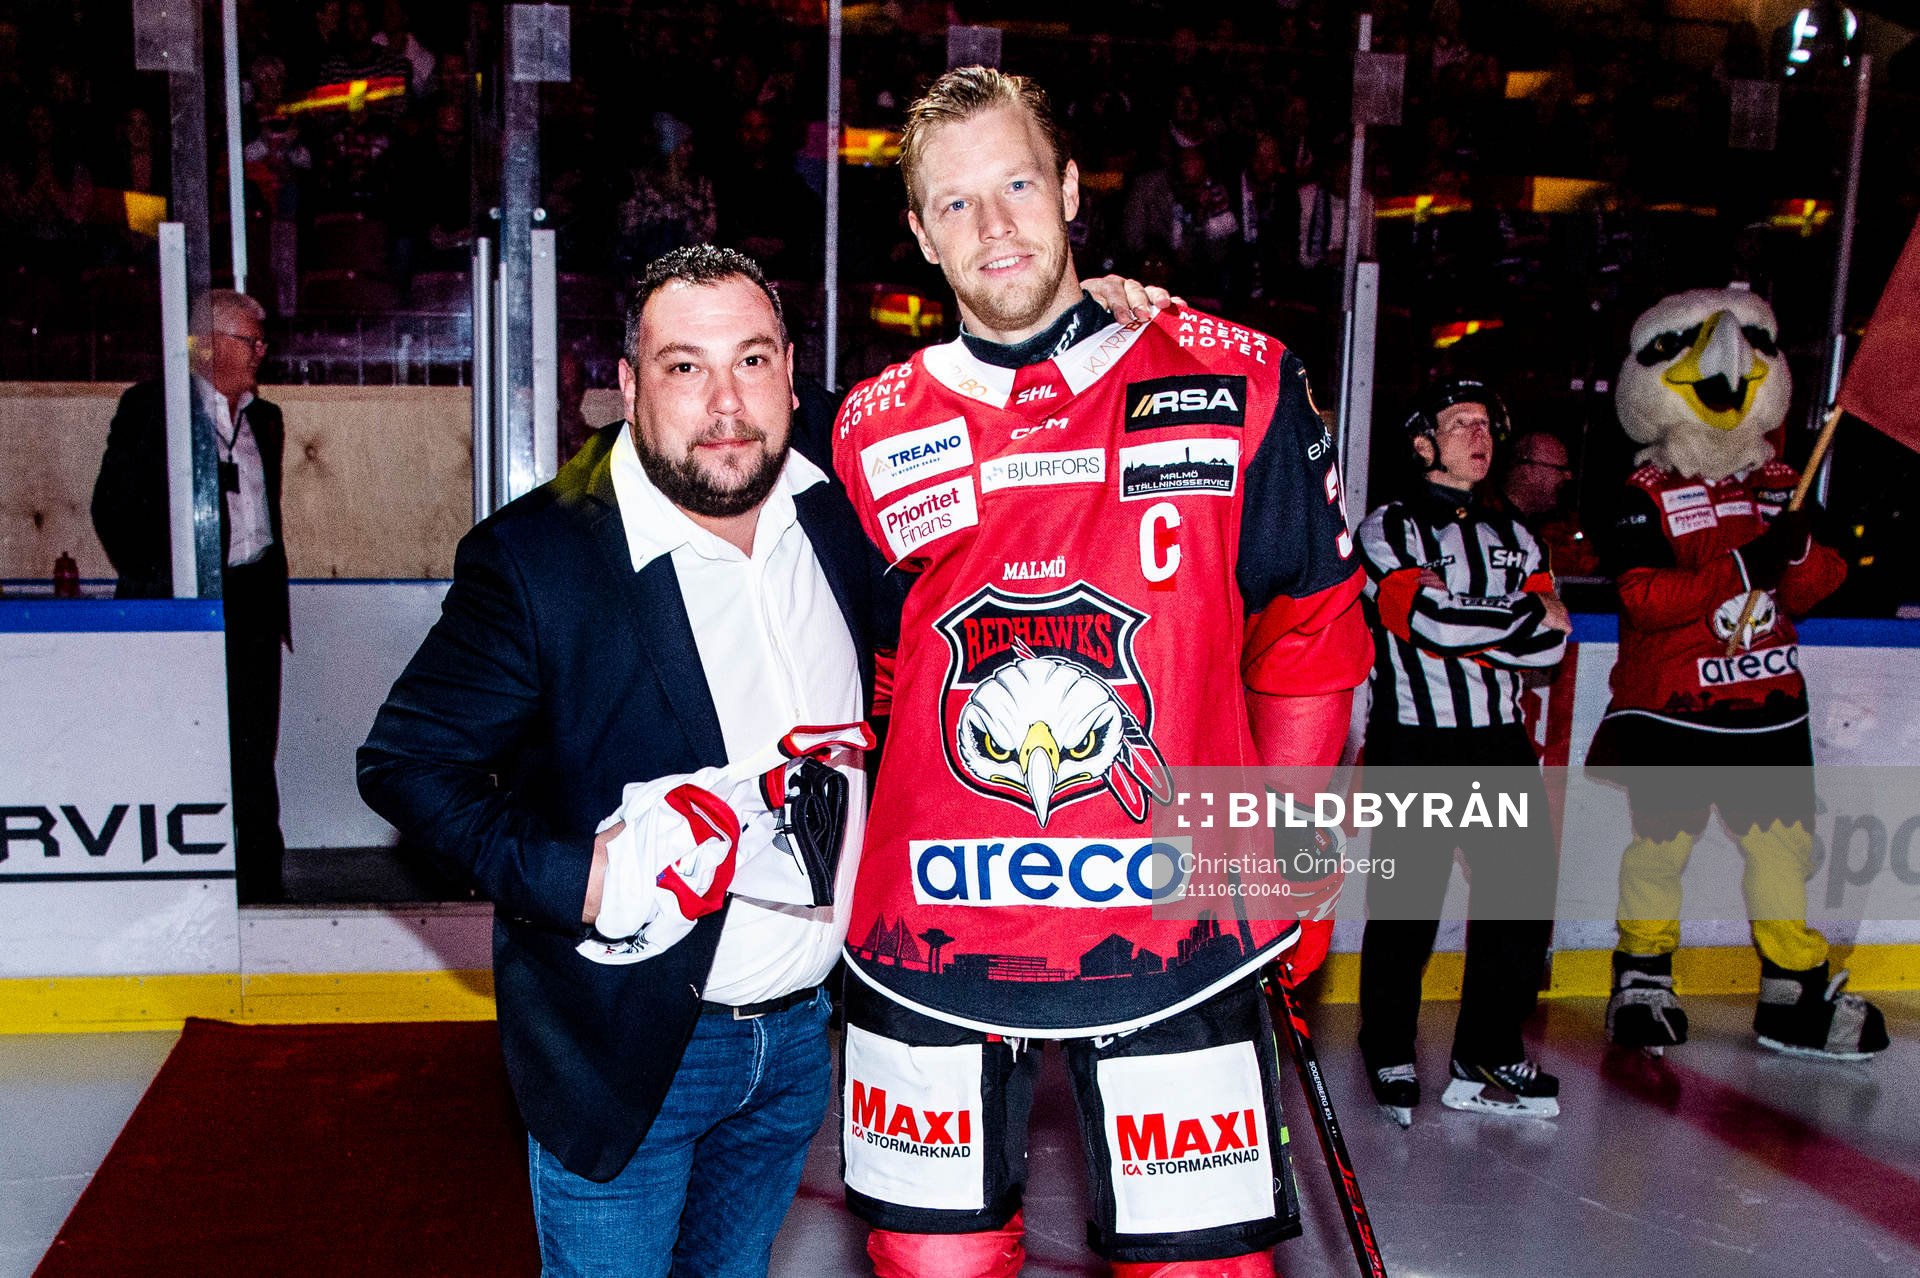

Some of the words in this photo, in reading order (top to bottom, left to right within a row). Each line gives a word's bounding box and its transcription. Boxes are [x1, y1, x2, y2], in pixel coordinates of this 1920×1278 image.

[1179, 311, 1268, 342] MALMÖ
[1179, 321, 1268, 351] ARENA
[1178, 335, 1266, 365] HOTEL
[1015, 384, 1058, 405] SHL
[840, 394, 906, 440] HOTEL
[888, 435, 962, 467] TREANO
[1007, 456, 1100, 482] BJURFORS
[1160, 470, 1199, 481] MALMÖ
[1127, 479, 1230, 493] STÄLLNINGSSERVICE
[886, 487, 961, 534] Prioritet
[899, 513, 952, 548] Finans
[1139, 502, 1181, 583] C
[1002, 556, 1066, 581] MALMÖ
[1492, 549, 1525, 570] SH
[963, 614, 1115, 674] REDHAWKS
[916, 842, 1186, 903] areco
[852, 1078, 971, 1145] MAXI
[852, 1124, 865, 1143] ICA
[867, 1131, 971, 1158] STORMARKNAD
[1116, 1108, 1258, 1162] MAXI
[1122, 1163, 1143, 1176] ICA
[1147, 1148, 1260, 1176] STORMARKNAD
